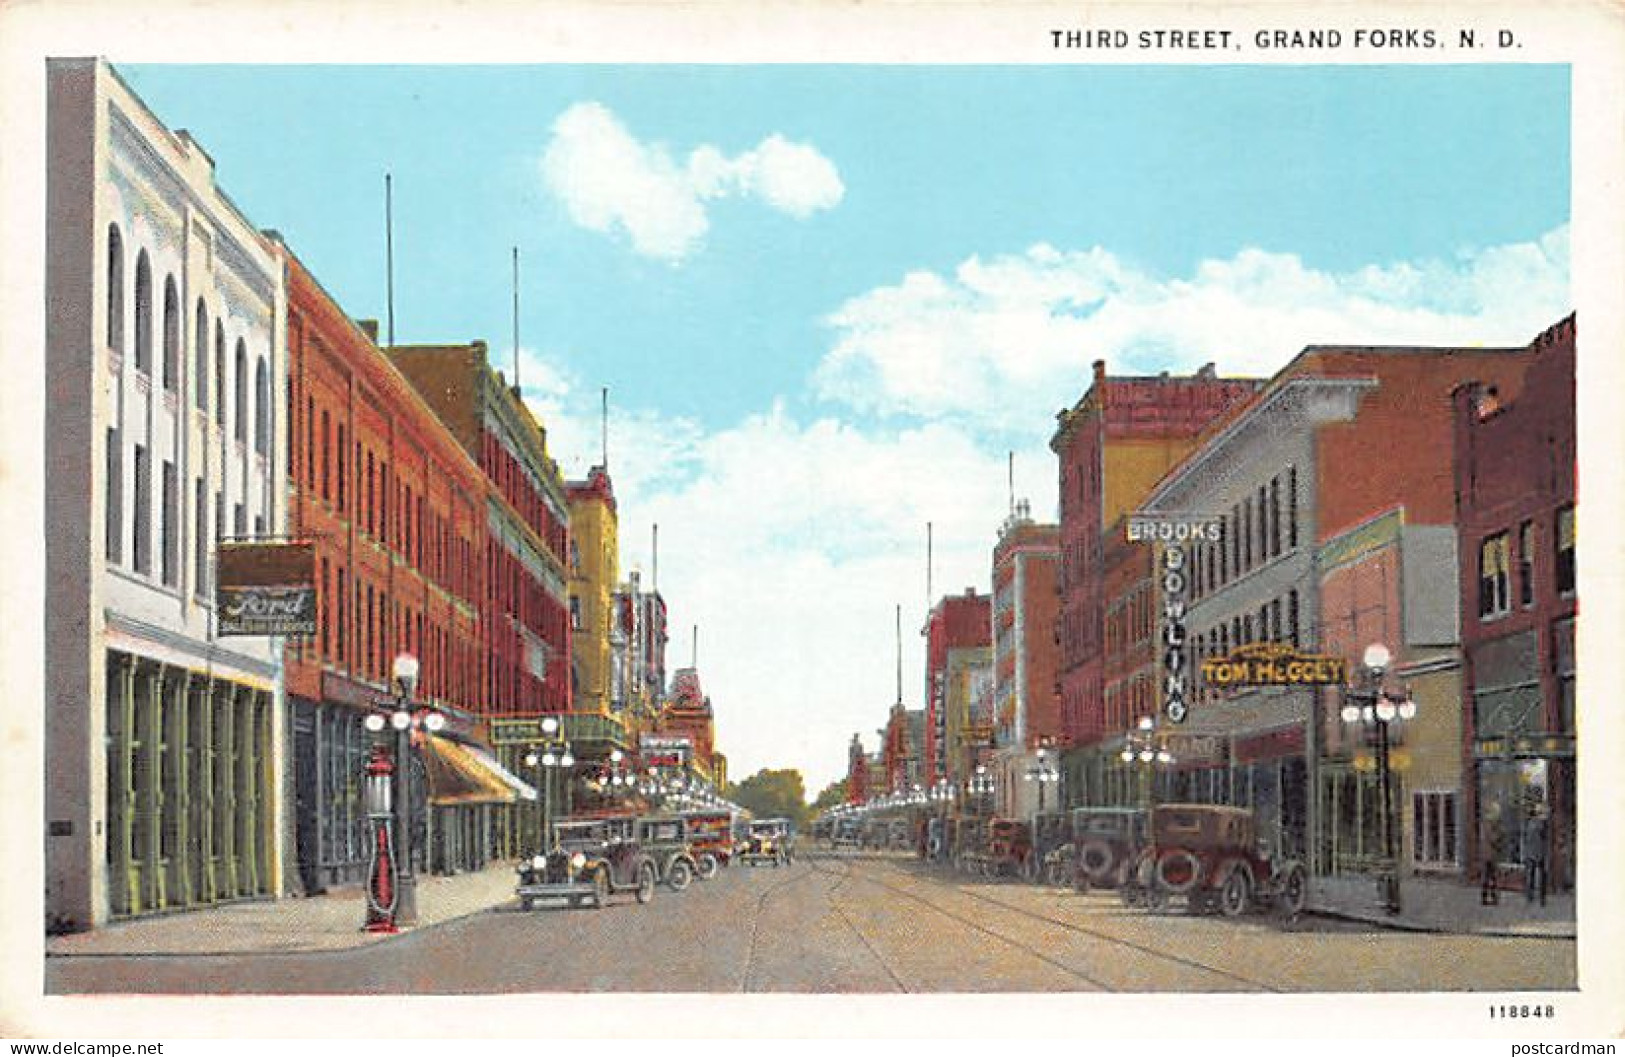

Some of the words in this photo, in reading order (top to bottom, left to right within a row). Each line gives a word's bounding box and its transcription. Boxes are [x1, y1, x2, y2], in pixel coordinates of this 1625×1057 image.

[1050, 30, 1129, 48] THIRD
[1139, 30, 1241, 51] STREET,
[1255, 30, 1342, 48] GRAND
[1498, 30, 1523, 48] D.
[1126, 521, 1222, 542] BROOKS
[1164, 547, 1187, 722] BOWLING
[1200, 662, 1250, 683] TOM
[1489, 1005, 1555, 1018] 118848
